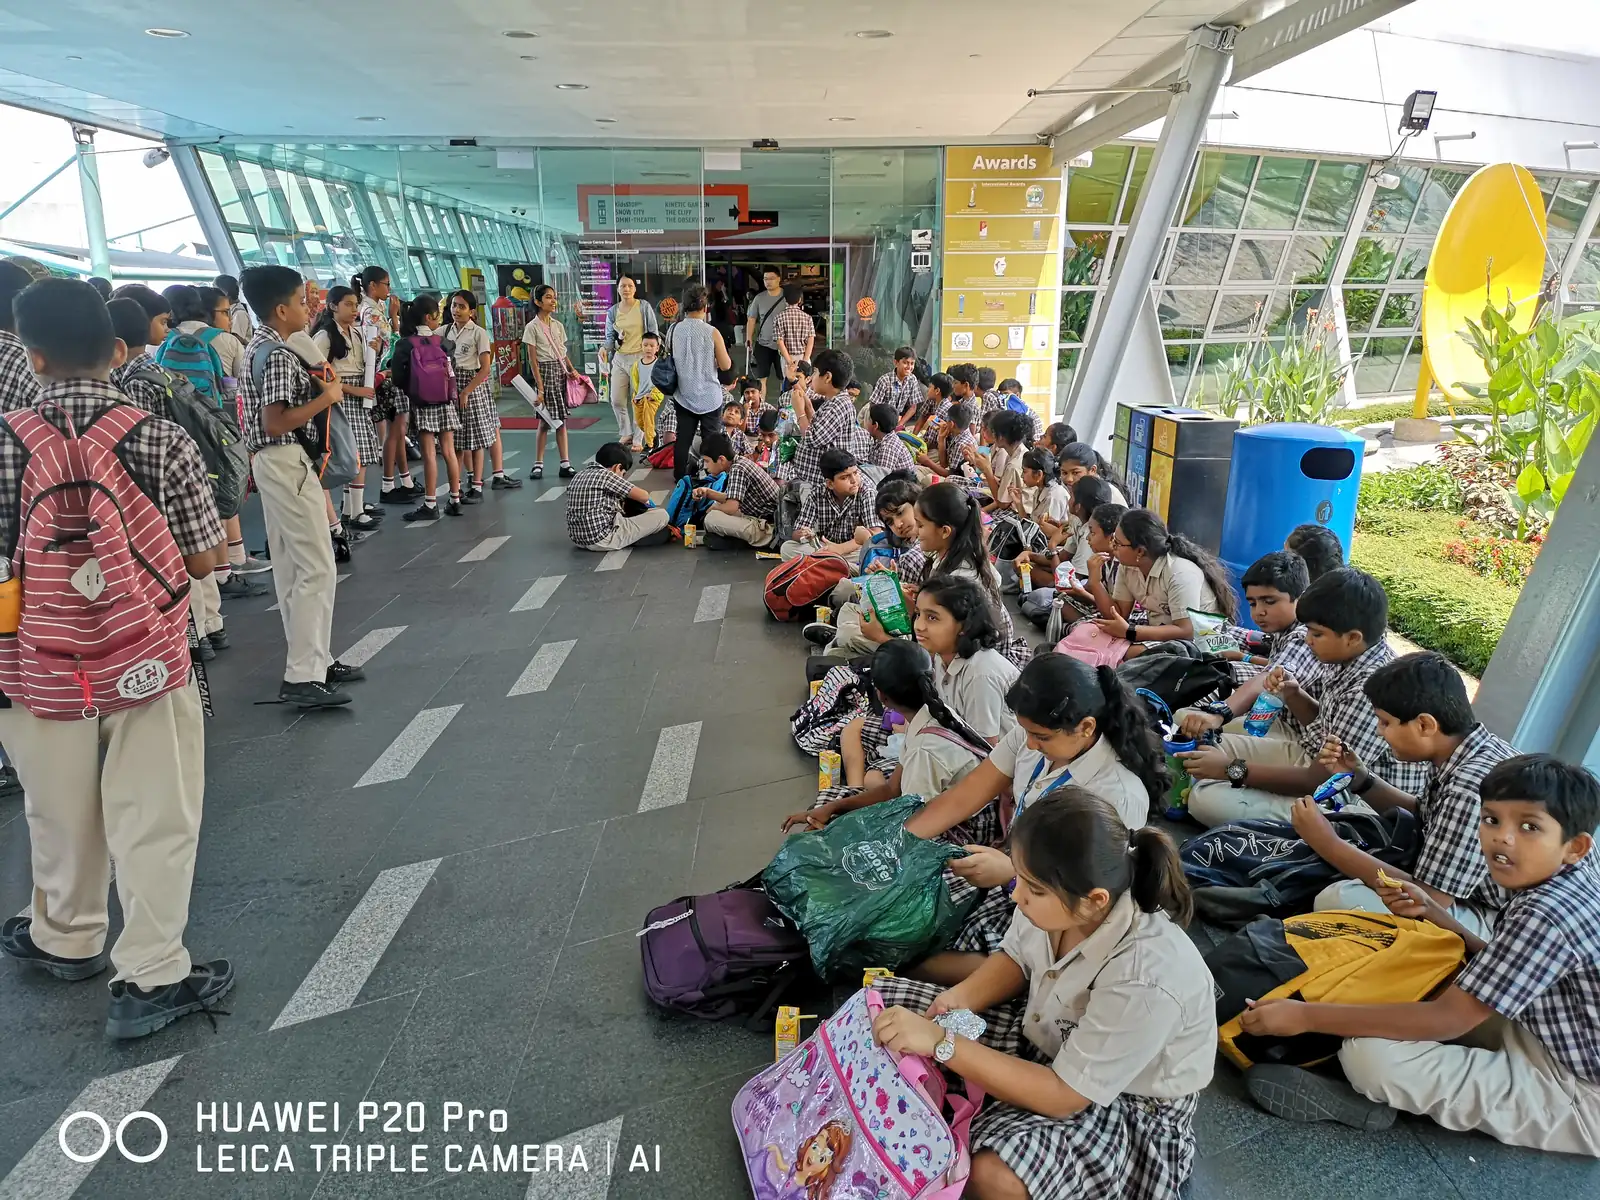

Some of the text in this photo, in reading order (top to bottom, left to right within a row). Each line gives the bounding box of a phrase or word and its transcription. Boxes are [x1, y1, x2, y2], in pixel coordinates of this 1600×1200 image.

[972, 154, 1037, 170] Awards
[190, 621, 199, 648] LIMITED
[1206, 636, 1229, 647] POTATO
[123, 665, 158, 690] CLN
